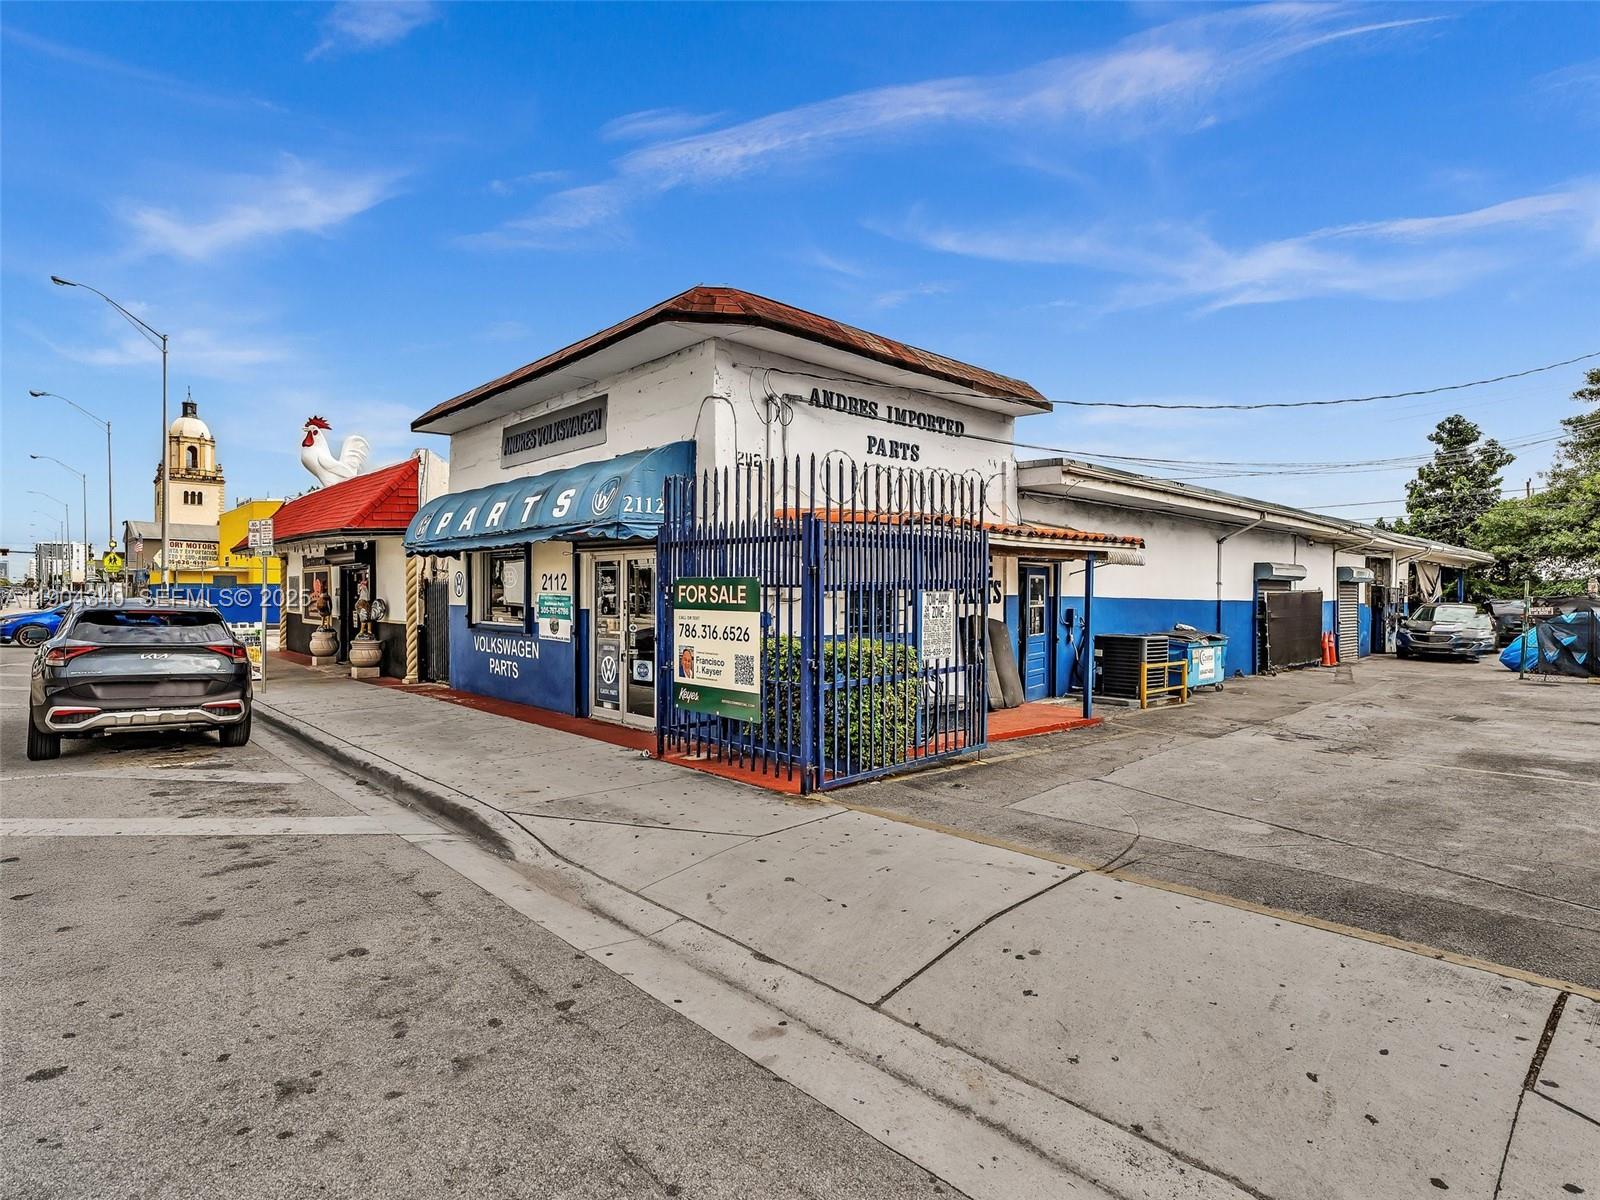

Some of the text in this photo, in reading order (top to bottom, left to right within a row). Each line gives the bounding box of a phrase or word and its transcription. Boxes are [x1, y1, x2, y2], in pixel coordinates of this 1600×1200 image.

[808, 387, 965, 437] ANDRES IMPORTED
[503, 408, 603, 456] ANDRES VOLKSWAGEN
[866, 435, 920, 462] PARTS
[435, 489, 576, 535] PARTS
[623, 495, 664, 513] 2112
[169, 541, 217, 550] ORY MOTORS
[541, 573, 567, 591] 2112
[678, 585, 747, 605] FOR SALE
[932, 606, 944, 618] ZONE
[679, 624, 750, 642] 786.316.6526
[474, 635, 540, 660] VOLKSWAGEN
[489, 658, 519, 679] PARTS
[696, 656, 725, 667] Francisco
[701, 667, 722, 678] Kayser
[679, 687, 699, 703] Keyes
